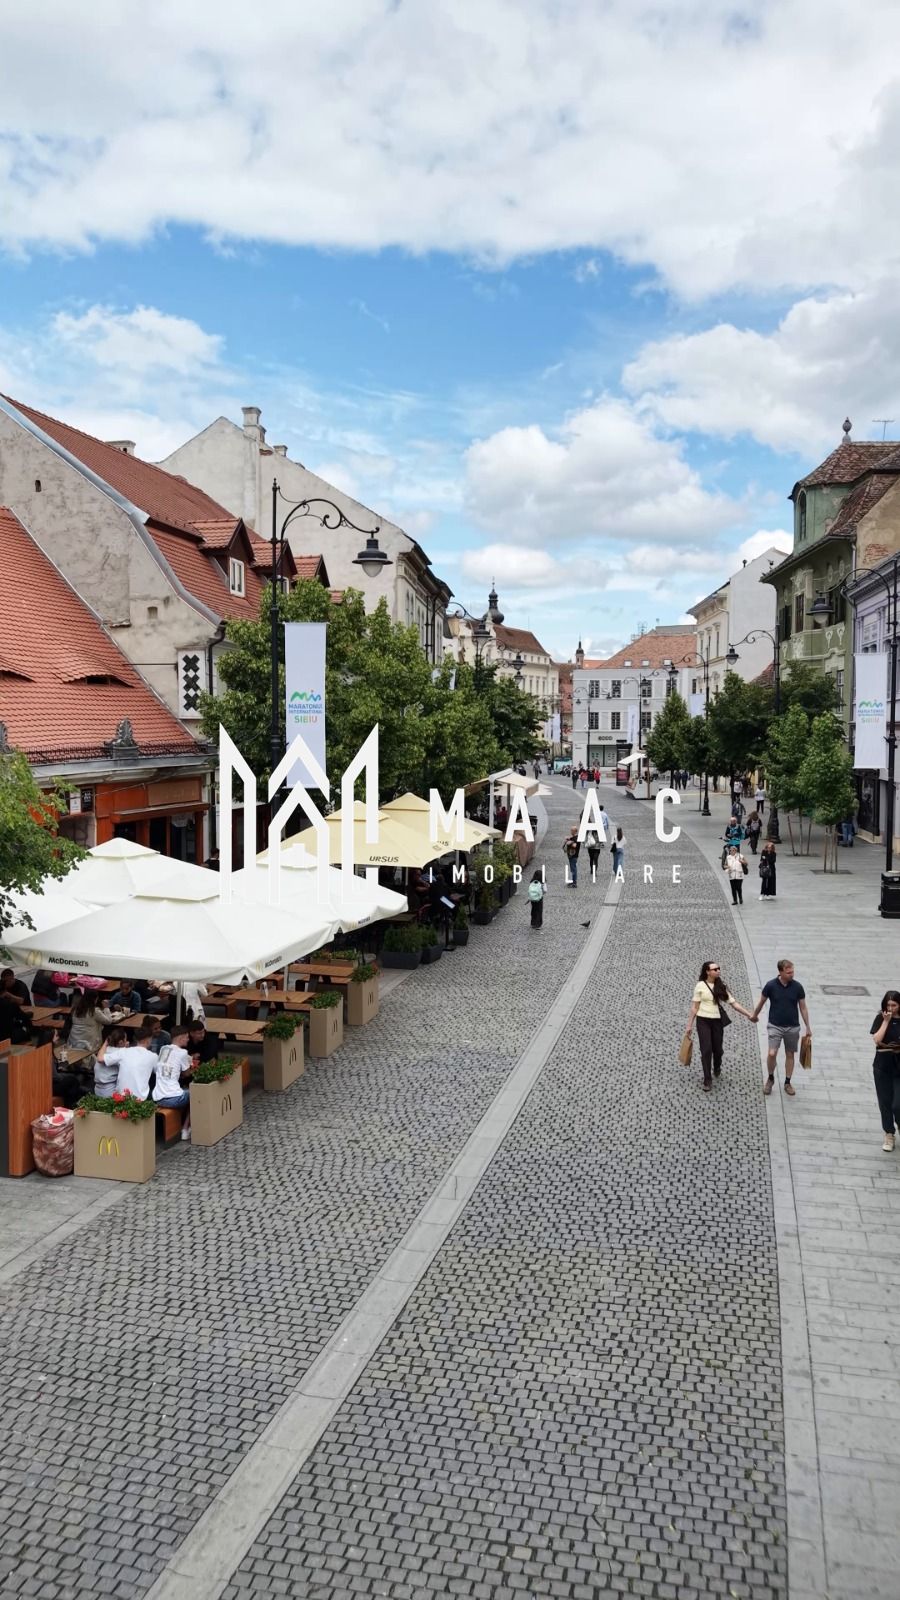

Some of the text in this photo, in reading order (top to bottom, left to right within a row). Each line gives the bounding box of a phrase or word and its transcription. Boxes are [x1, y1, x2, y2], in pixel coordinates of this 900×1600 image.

[294, 715, 318, 724] SIBIU
[369, 855, 400, 863] URSUS
[48, 956, 89, 967] McDonald's
